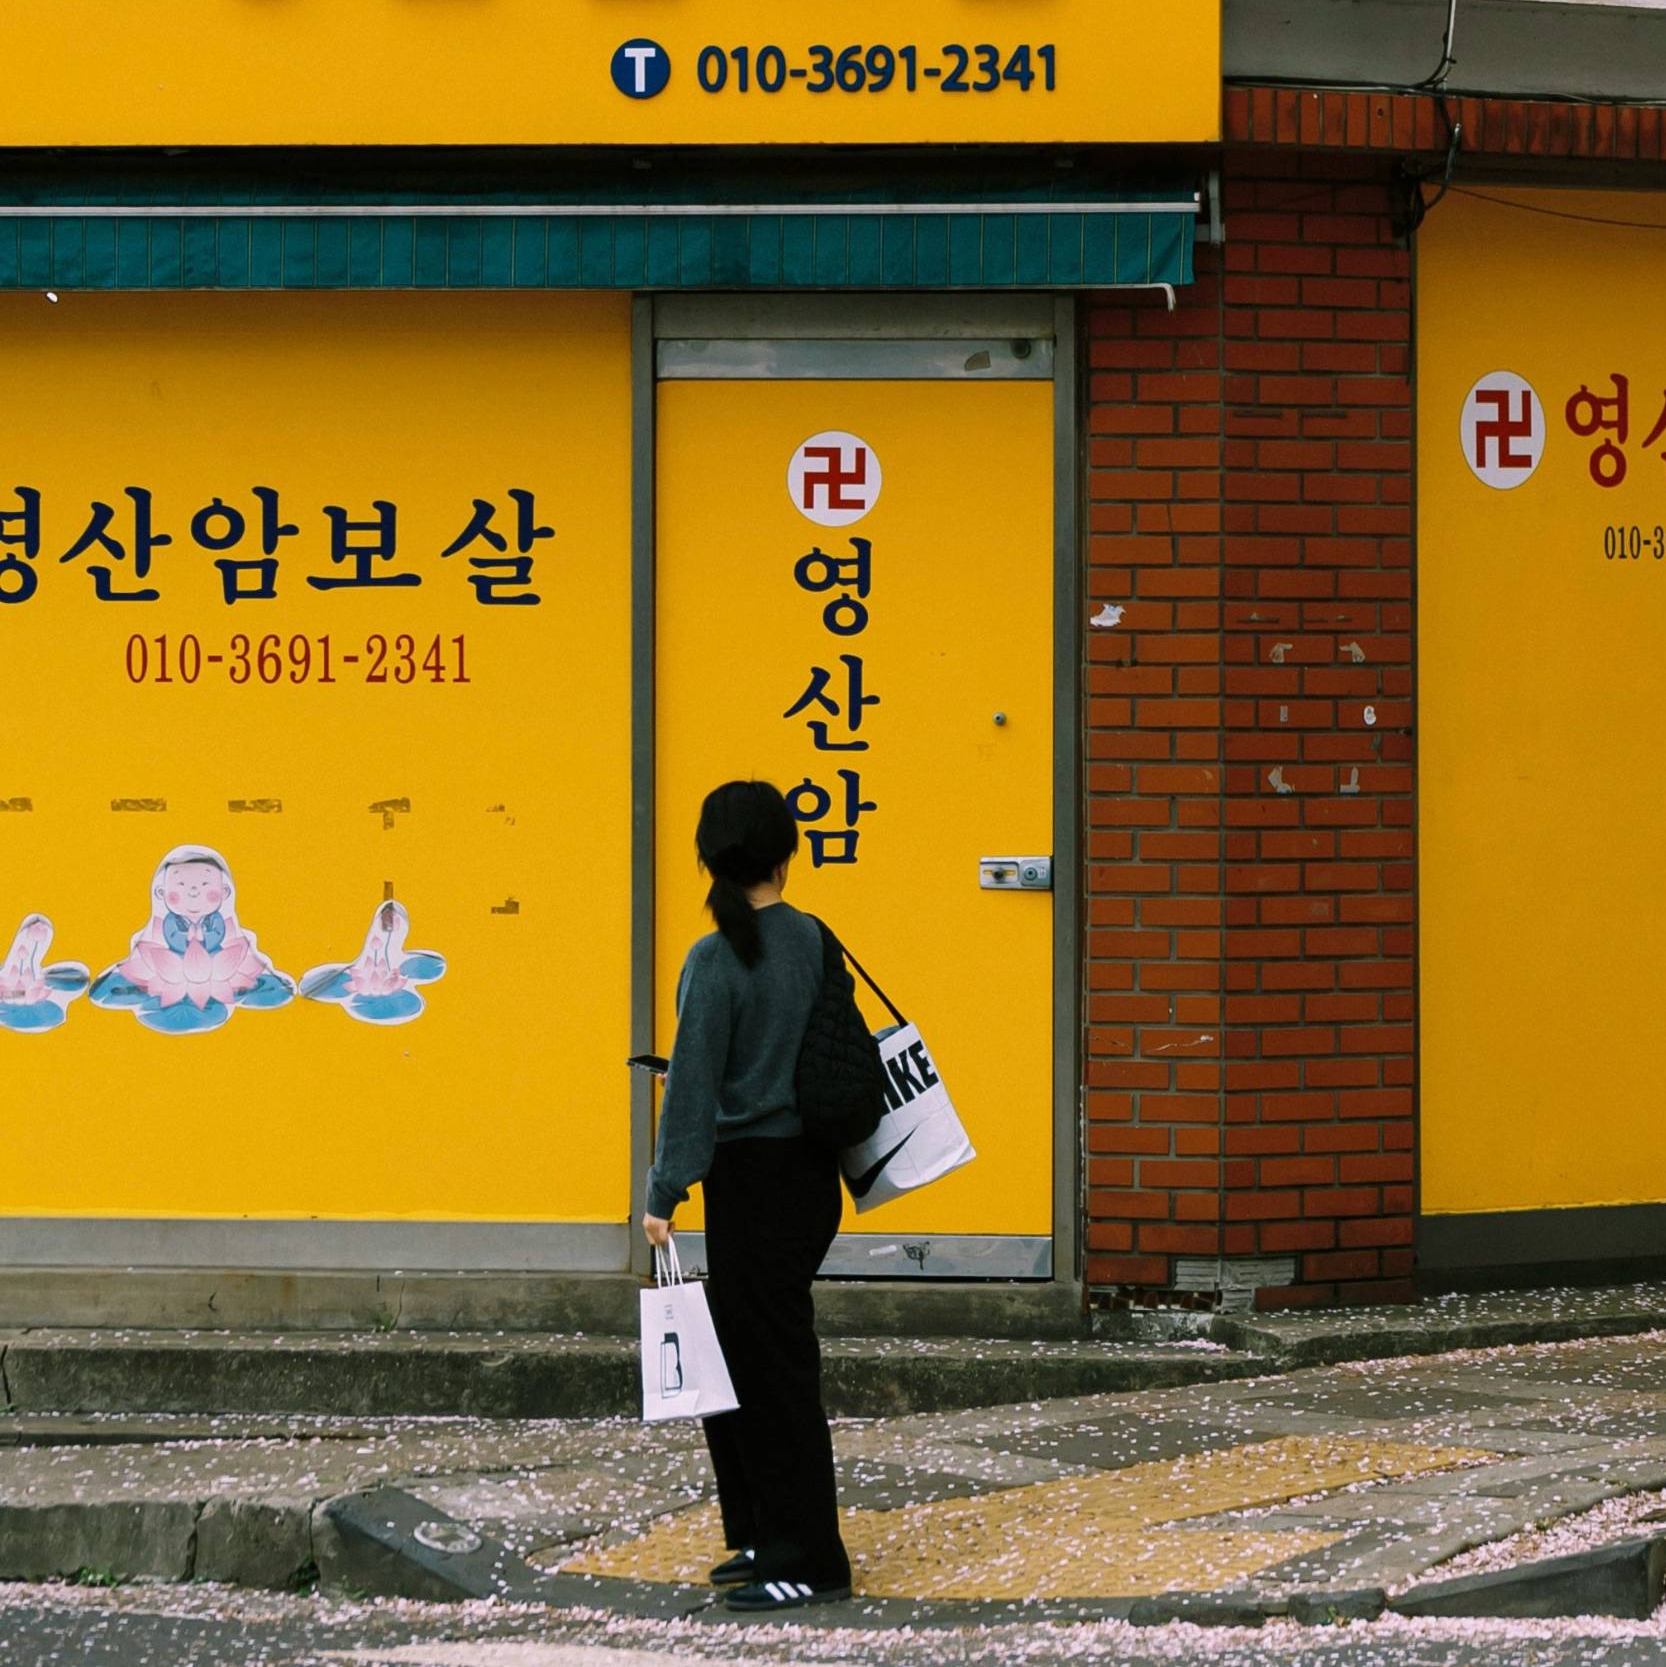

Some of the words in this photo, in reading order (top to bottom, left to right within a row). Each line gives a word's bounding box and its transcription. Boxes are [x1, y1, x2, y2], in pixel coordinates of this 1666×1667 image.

[696, 43, 1058, 94] 010-3691-2341
[0, 486, 556, 606] 영산암보살
[125, 633, 472, 685] 010-3691-2341
[782, 536, 882, 869] 영산암
[879, 1039, 940, 1117] IKE
